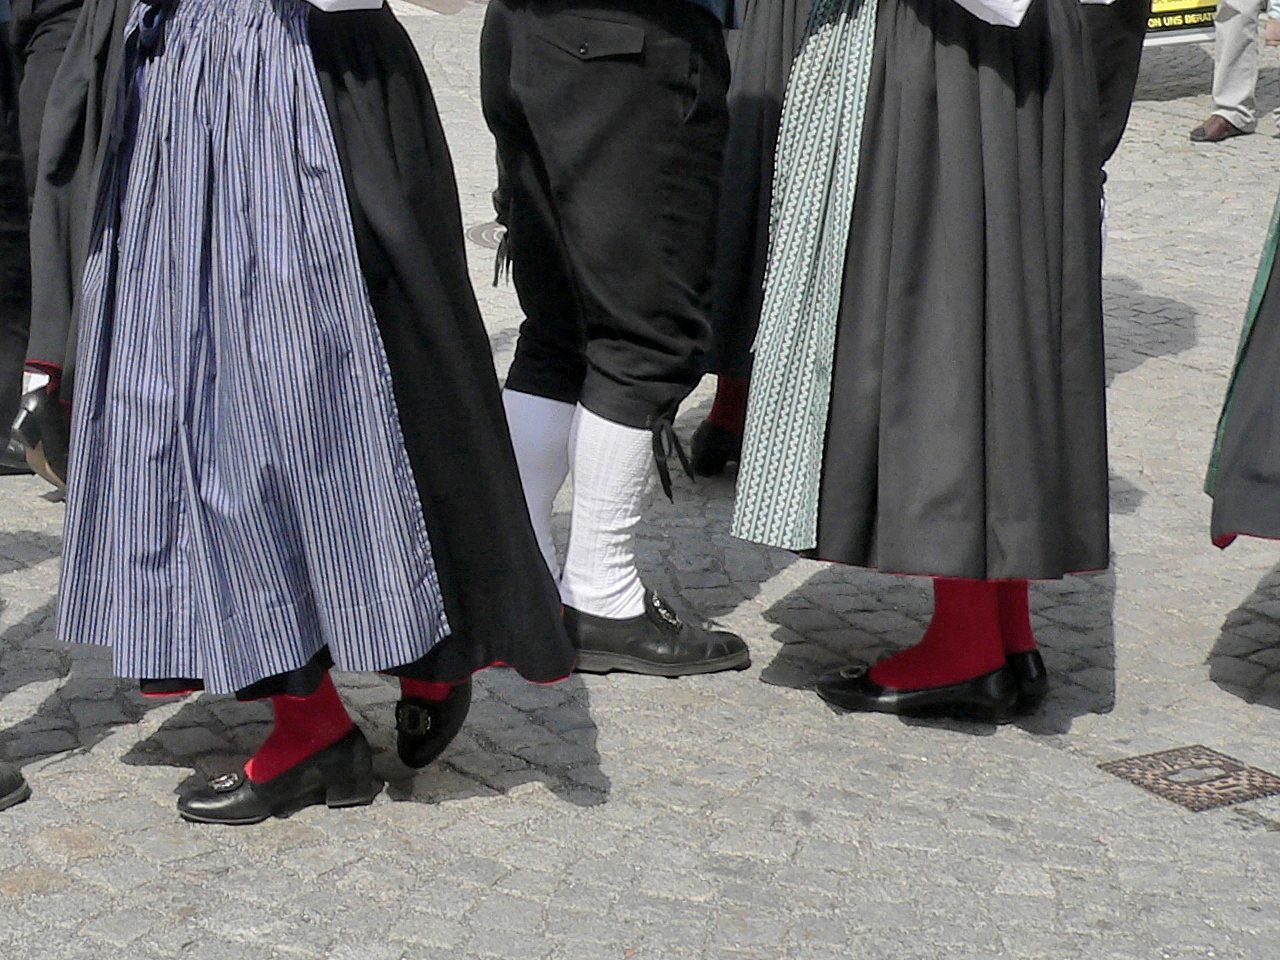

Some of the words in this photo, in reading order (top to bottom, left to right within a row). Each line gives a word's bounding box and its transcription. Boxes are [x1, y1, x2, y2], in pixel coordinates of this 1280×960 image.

[1147, 16, 1162, 28] ON
[1163, 14, 1184, 27] UNS
[1184, 11, 1217, 24] BERAT
